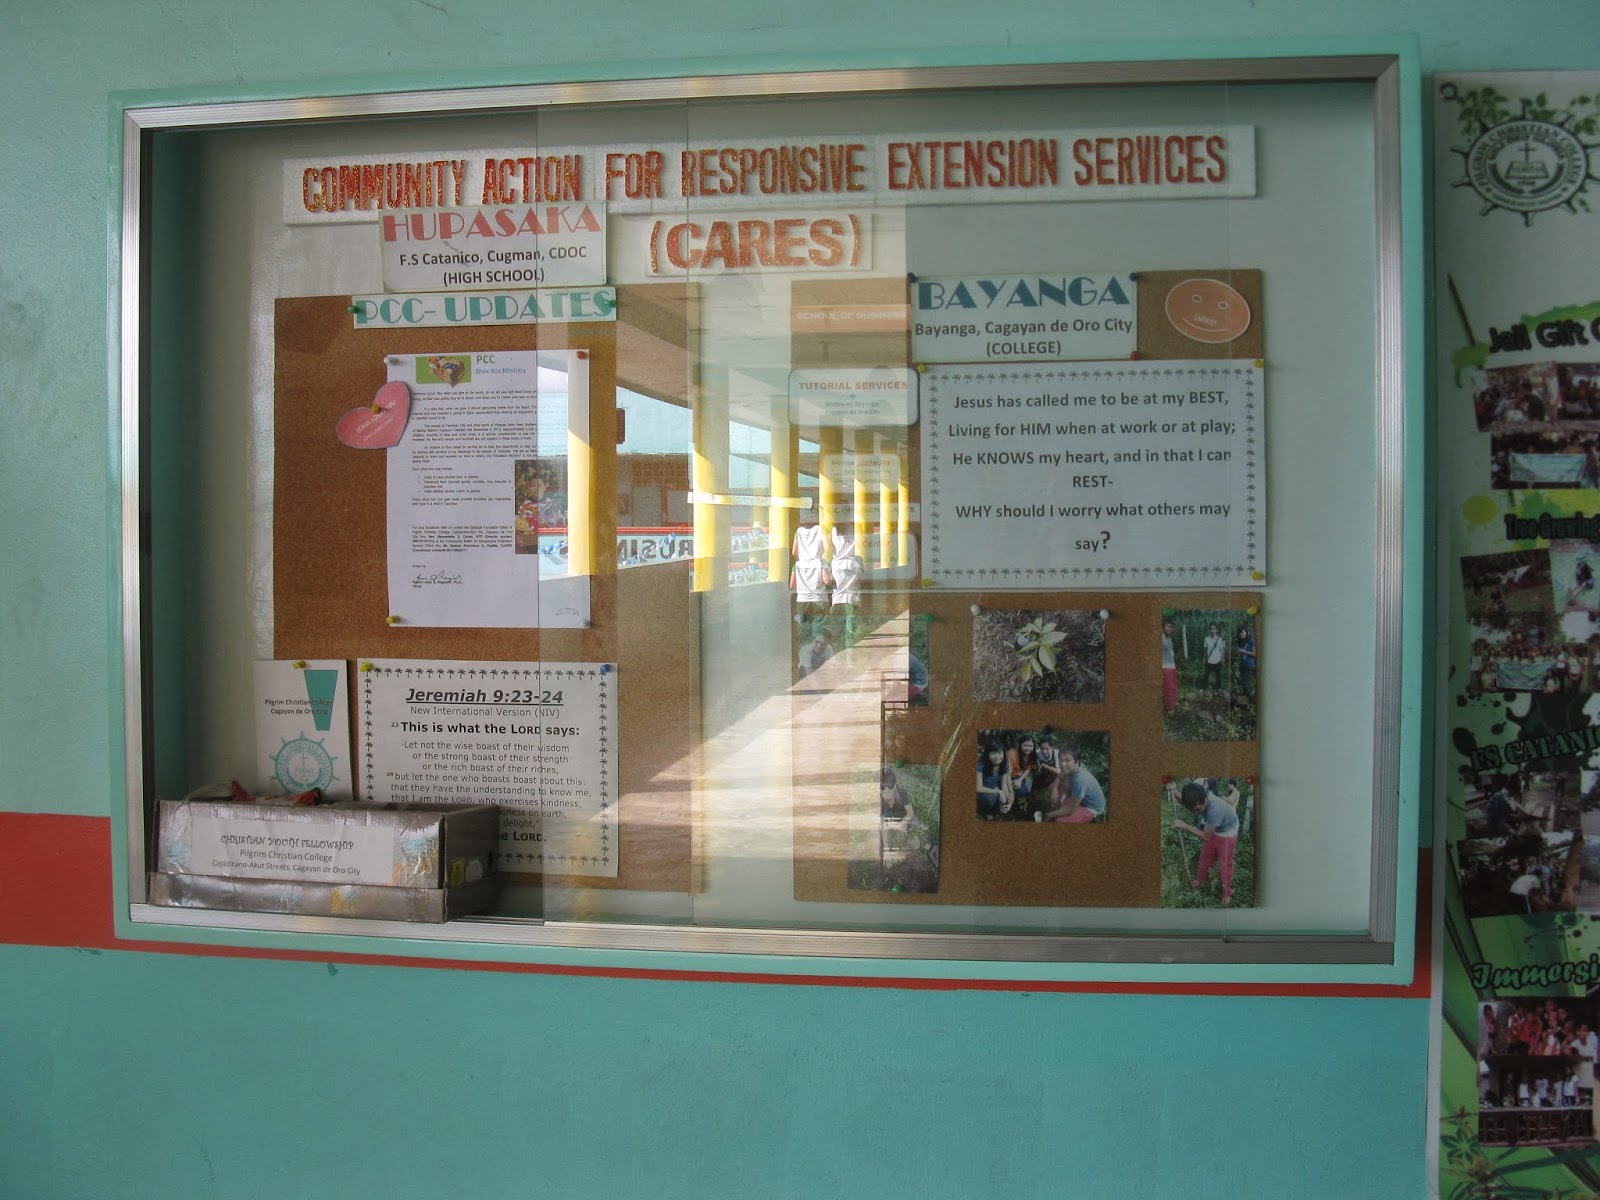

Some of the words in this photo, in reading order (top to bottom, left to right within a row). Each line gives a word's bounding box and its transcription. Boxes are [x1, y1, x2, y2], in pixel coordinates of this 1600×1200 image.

[1488, 123, 1558, 141] CHRISTIAN
[1560, 137, 1581, 184] COLLEGE
[303, 159, 465, 213] COMMUNITY
[482, 154, 581, 205] ACTION
[605, 150, 663, 200] FOR
[681, 143, 864, 197] RESPONSIVE
[888, 138, 1057, 191] EXTENSION
[1073, 134, 1226, 187] SERVICES
[383, 204, 601, 243] HUPASAKA
[649, 213, 862, 274] (CARES)
[422, 251, 484, 266] Catanico,
[487, 249, 544, 265] Cugman,
[549, 246, 587, 259] CDOC
[443, 270, 482, 287] (HIGH
[486, 268, 545, 283] SCHOOL)
[917, 275, 1131, 312] BAYANGA
[444, 290, 613, 321] UPDATES
[797, 312, 837, 320] SCHOOL
[840, 312, 854, 320] OF
[856, 311, 905, 319] BUSINESS
[914, 321, 981, 340] Bayanga,
[985, 320, 1046, 339] Cagayan
[1051, 319, 1069, 333] de
[1073, 318, 1100, 333] Oro
[1104, 317, 1132, 335] City
[986, 339, 1062, 357] (COLLEGE)
[476, 355, 495, 364] PCC
[502, 367, 526, 375] Ministry
[799, 381, 851, 390] TUTORIAL
[855, 381, 908, 390] SERVICES
[385, 399, 397, 410] YOU
[954, 396, 992, 408] Jesus
[997, 395, 1022, 407] has
[1026, 394, 1069, 407] called
[1074, 396, 1096, 406] me
[1101, 393, 1116, 405] to
[1121, 393, 1138, 405] be
[1143, 393, 1157, 404] at
[1162, 394, 1185, 406] my
[1189, 392, 1228, 405] BEST,
[949, 424, 990, 439] Living
[995, 424, 1016, 436] for
[1021, 423, 1050, 435] HIM
[1056, 422, 1096, 434] when
[1101, 422, 1115, 434] at
[1120, 421, 1157, 433] work
[1162, 424, 1176, 433] or
[1181, 421, 1196, 432] at
[1201, 420, 1235, 435] play;
[954, 453, 972, 464] He
[977, 452, 1034, 464] KNOWS
[1039, 454, 1061, 466] my
[1066, 451, 1109, 465] heart,
[1114, 450, 1141, 462] and
[1146, 450, 1159, 461] in
[1164, 449, 1194, 461] that
[1199, 449, 1202, 461] I
[1207, 451, 1231, 461] can
[1073, 475, 1113, 488] REST-
[956, 506, 992, 518] WHY
[996, 505, 1045, 517] should
[1051, 505, 1053, 516] I
[1058, 506, 1101, 519] worry
[1106, 503, 1143, 516] what
[1148, 503, 1194, 515] others
[1200, 505, 1230, 517] may
[863, 540, 891, 548] Centr
[1075, 531, 1111, 552] say?
[406, 688, 486, 702] Jeremiah
[493, 690, 563, 703] 9:23-24
[433, 707, 492, 716] International
[496, 708, 530, 716] Version
[535, 709, 560, 718] (NIV)
[401, 722, 428, 732] This
[433, 722, 443, 732] is
[448, 723, 480, 733] what
[485, 724, 506, 734] the
[511, 725, 541, 734] LORD
[546, 727, 580, 737] says:
[514, 743, 534, 751] their
[538, 744, 569, 752] wisdom
[1504, 724, 1600, 765] CATANI
[441, 753, 468, 761] strong
[472, 753, 495, 761] boast
[510, 754, 530, 762] their
[533, 755, 568, 764] strength
[482, 775, 510, 783] boasts
[540, 777, 564, 785] about
[567, 778, 585, 786] this:
[411, 784, 429, 792] they
[474, 785, 535, 796] understanding
[550, 788, 572, 796] know
[542, 810, 566, 819] earth,
[221, 835, 266, 845] CHRISTIAN
[268, 837, 299, 848] YOUTH
[301, 839, 354, 850] FELLOWSHIP
[513, 831, 547, 842] LORD.
[240, 849, 267, 859] Pilgrim
[268, 850, 303, 860] Christian
[304, 853, 333, 863] College
[212, 860, 265, 869] Capistrano-Akut
[266, 863, 291, 872] Streets,
[293, 864, 321, 873] Cagayan
[333, 866, 345, 874] Oro
[348, 867, 360, 876] City
